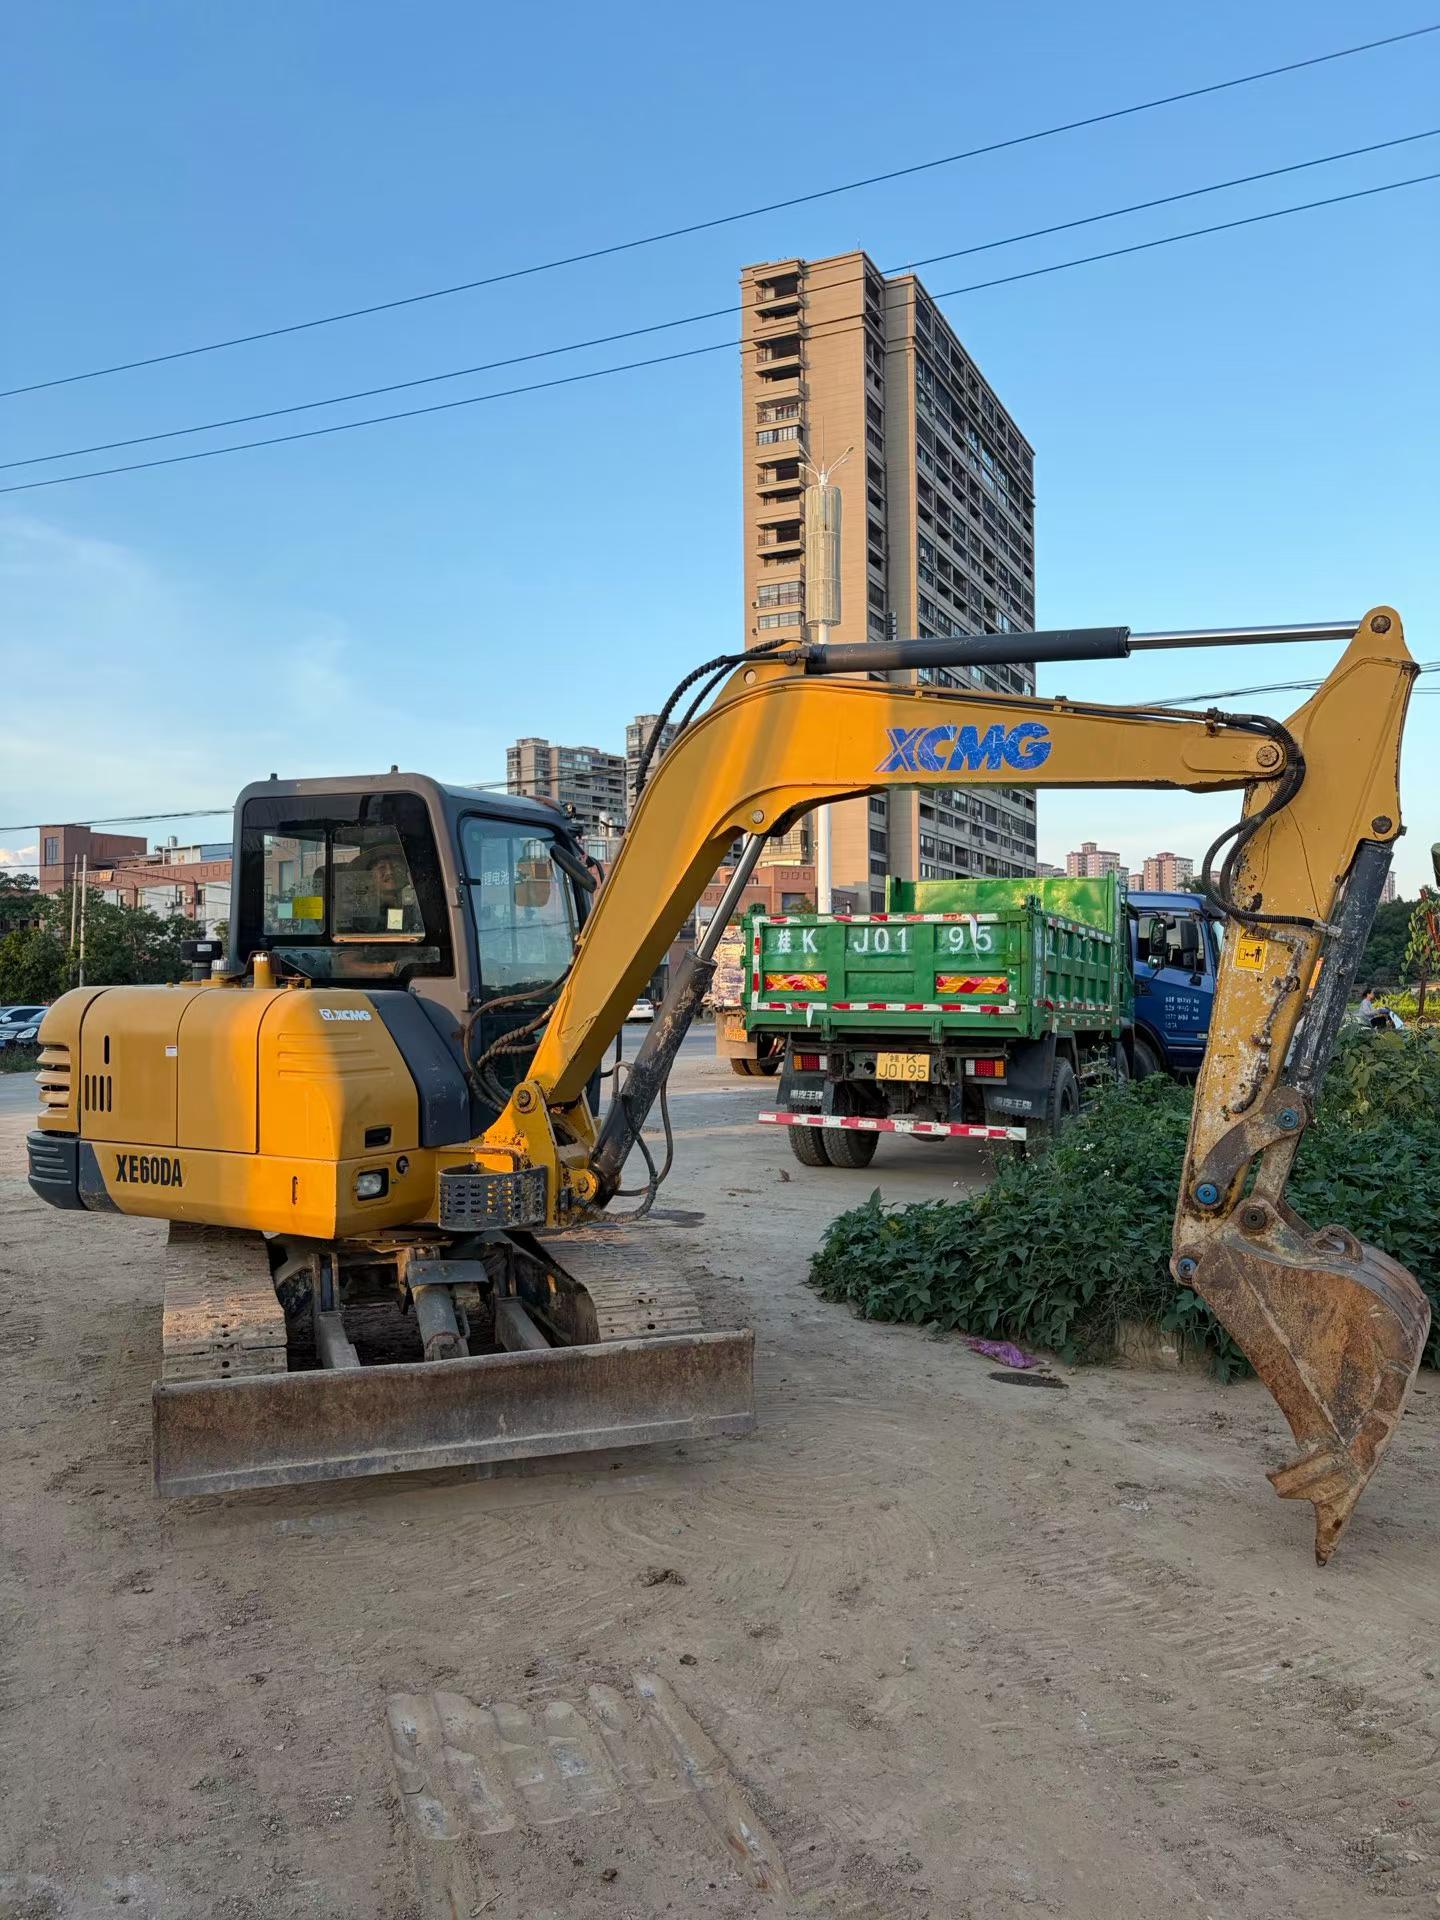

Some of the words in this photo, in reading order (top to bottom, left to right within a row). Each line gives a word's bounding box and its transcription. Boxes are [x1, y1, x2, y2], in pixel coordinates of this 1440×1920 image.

[875, 722, 1052, 772] XCMG
[853, 928, 907, 953] J01
[949, 926, 992, 953] 95
[333, 1009, 372, 1021] XCMG
[878, 1063, 927, 1080] J0195
[115, 1153, 183, 1188] XE60DA
